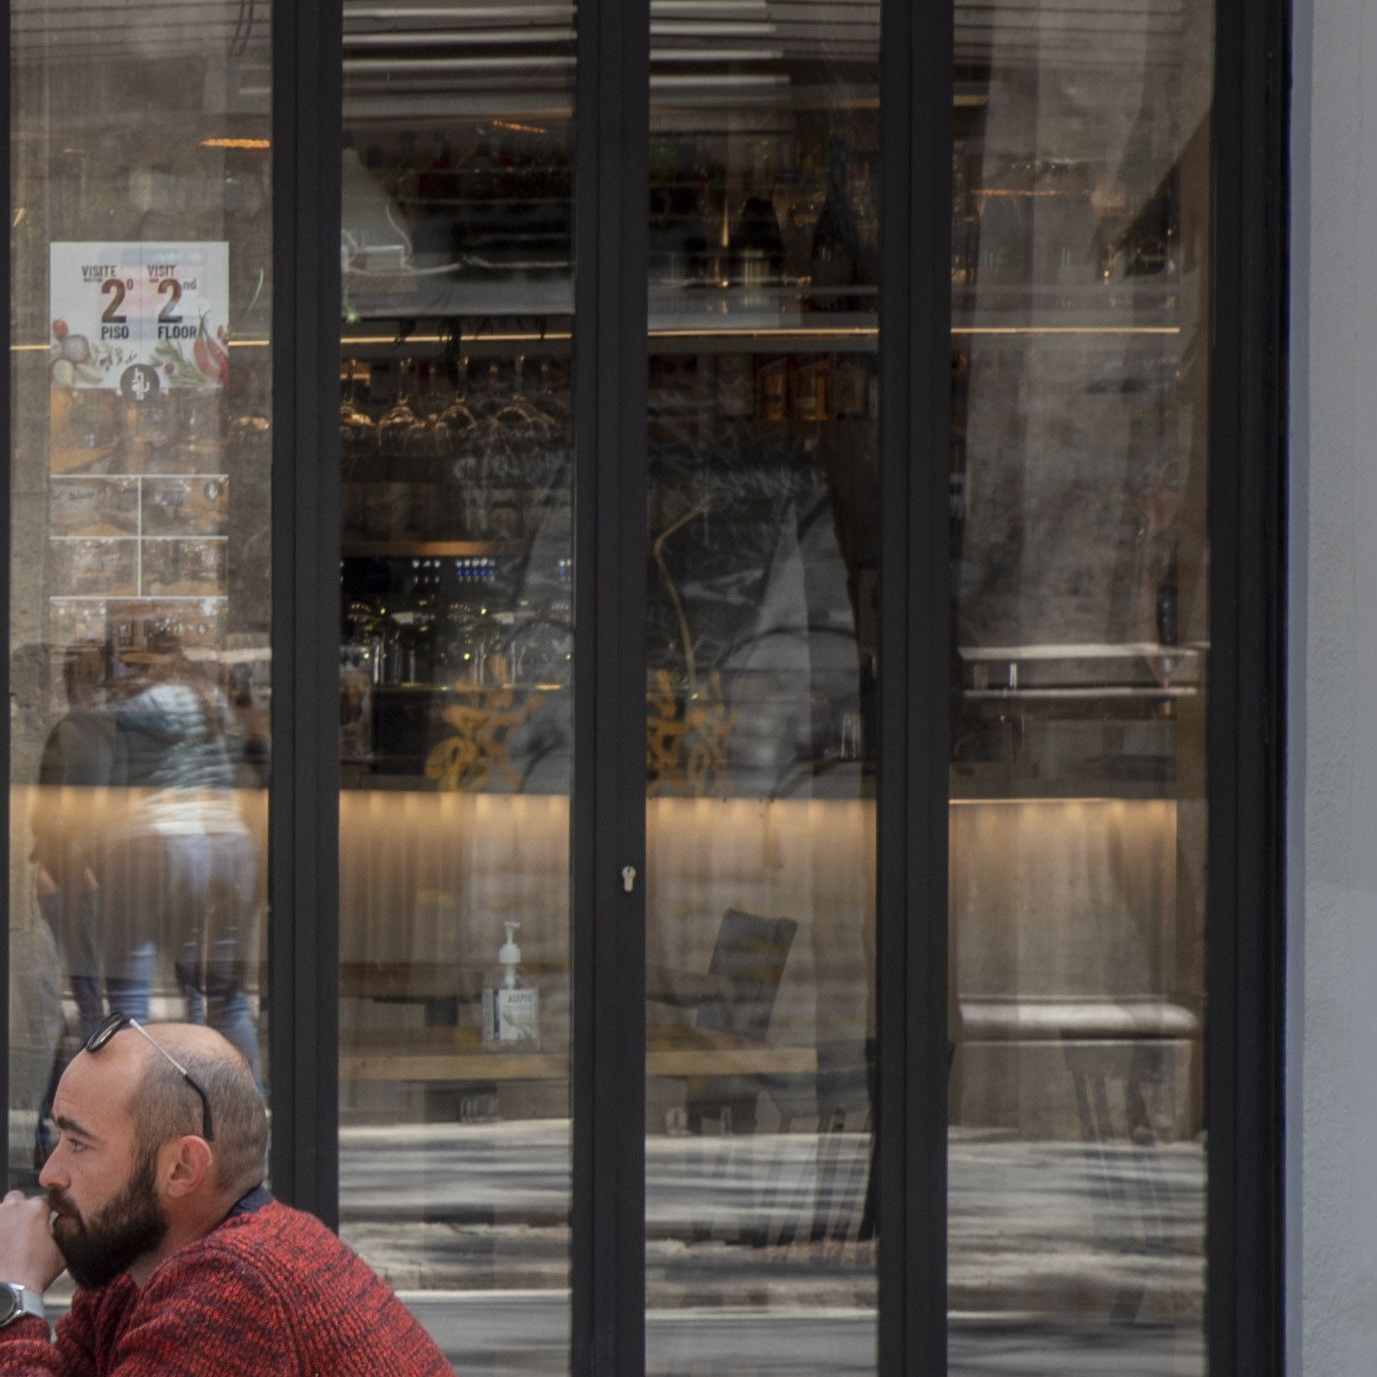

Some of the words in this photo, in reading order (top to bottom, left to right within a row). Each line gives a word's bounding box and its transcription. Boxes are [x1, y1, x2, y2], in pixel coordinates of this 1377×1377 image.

[82, 265, 117, 277] VISITE
[148, 265, 177, 277] VISIT
[101, 326, 130, 340] PISO
[158, 326, 196, 340] FLOOR
